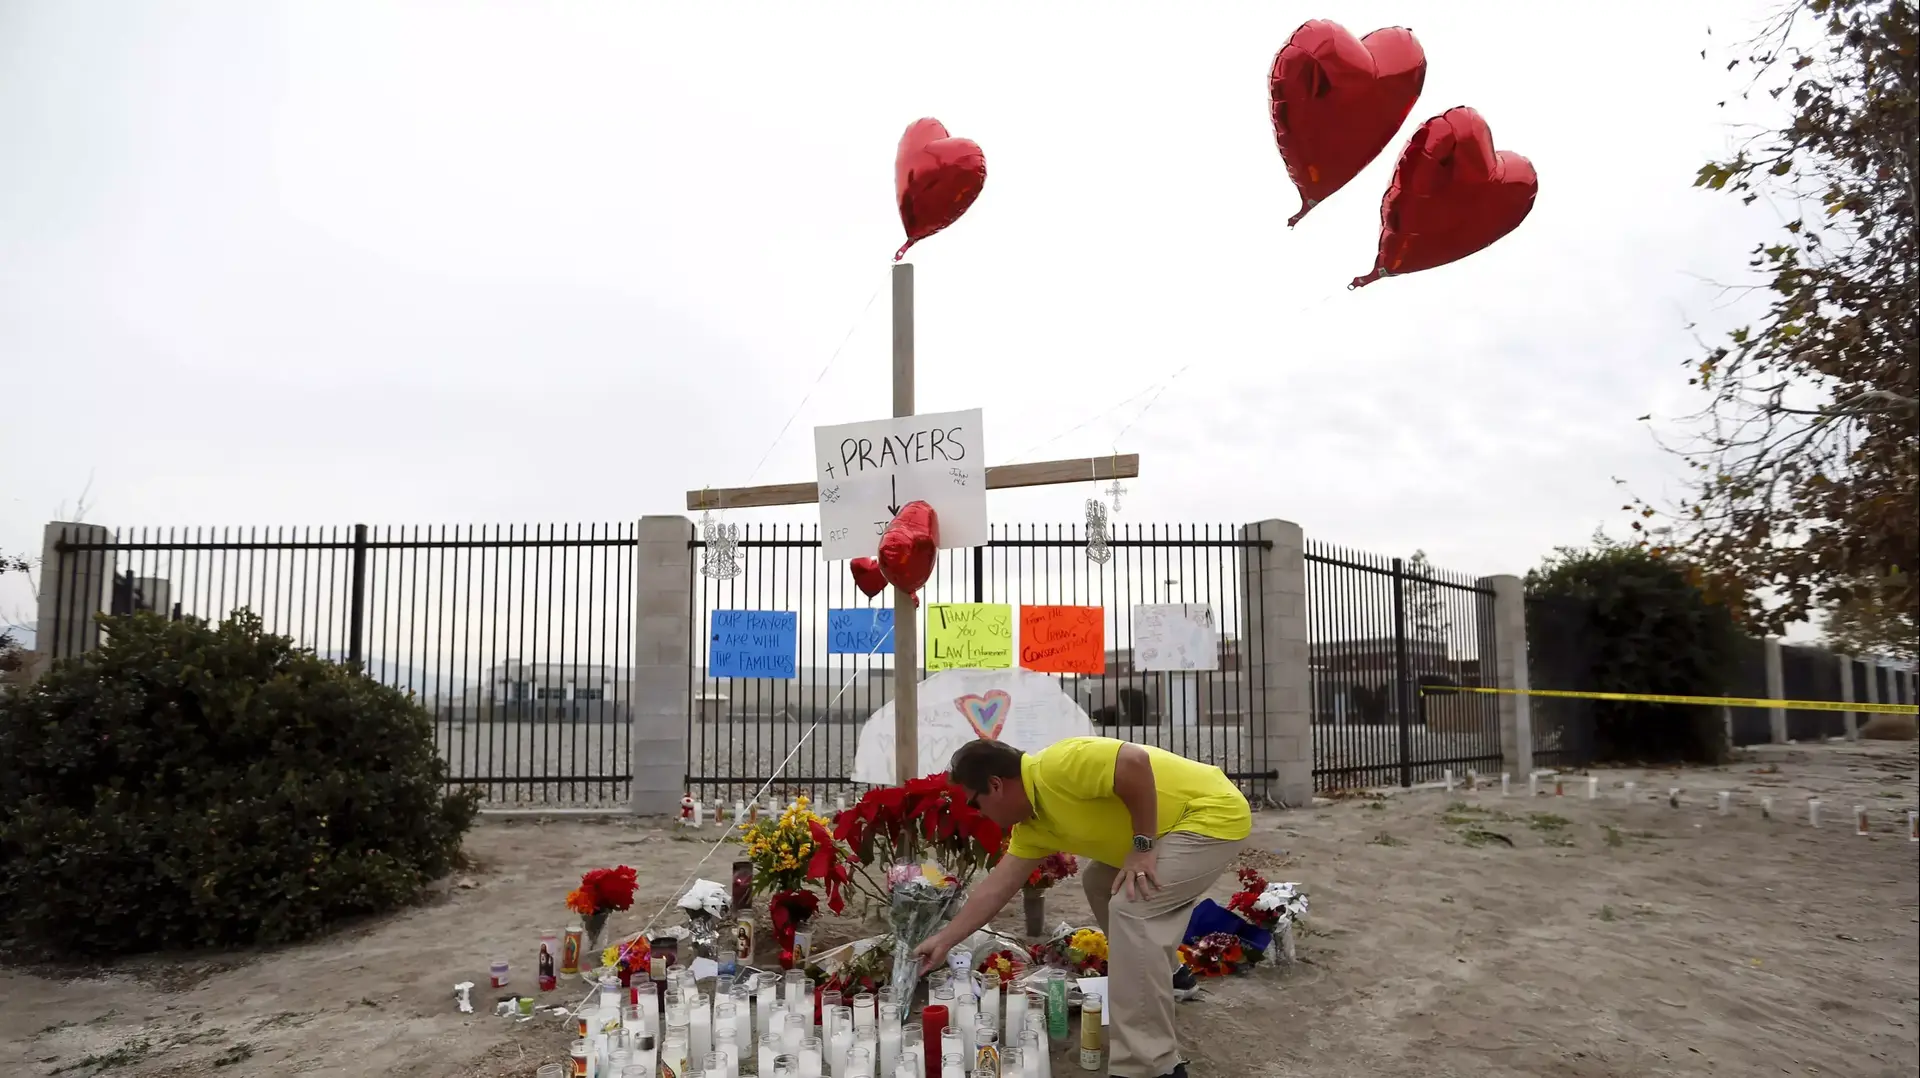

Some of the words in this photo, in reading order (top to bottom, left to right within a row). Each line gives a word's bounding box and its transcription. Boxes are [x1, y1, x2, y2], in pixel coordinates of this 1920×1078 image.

[840, 427, 966, 476] PRAYERS
[829, 528, 849, 542] RIP
[928, 605, 984, 629] THANK
[934, 638, 964, 659] LAW
